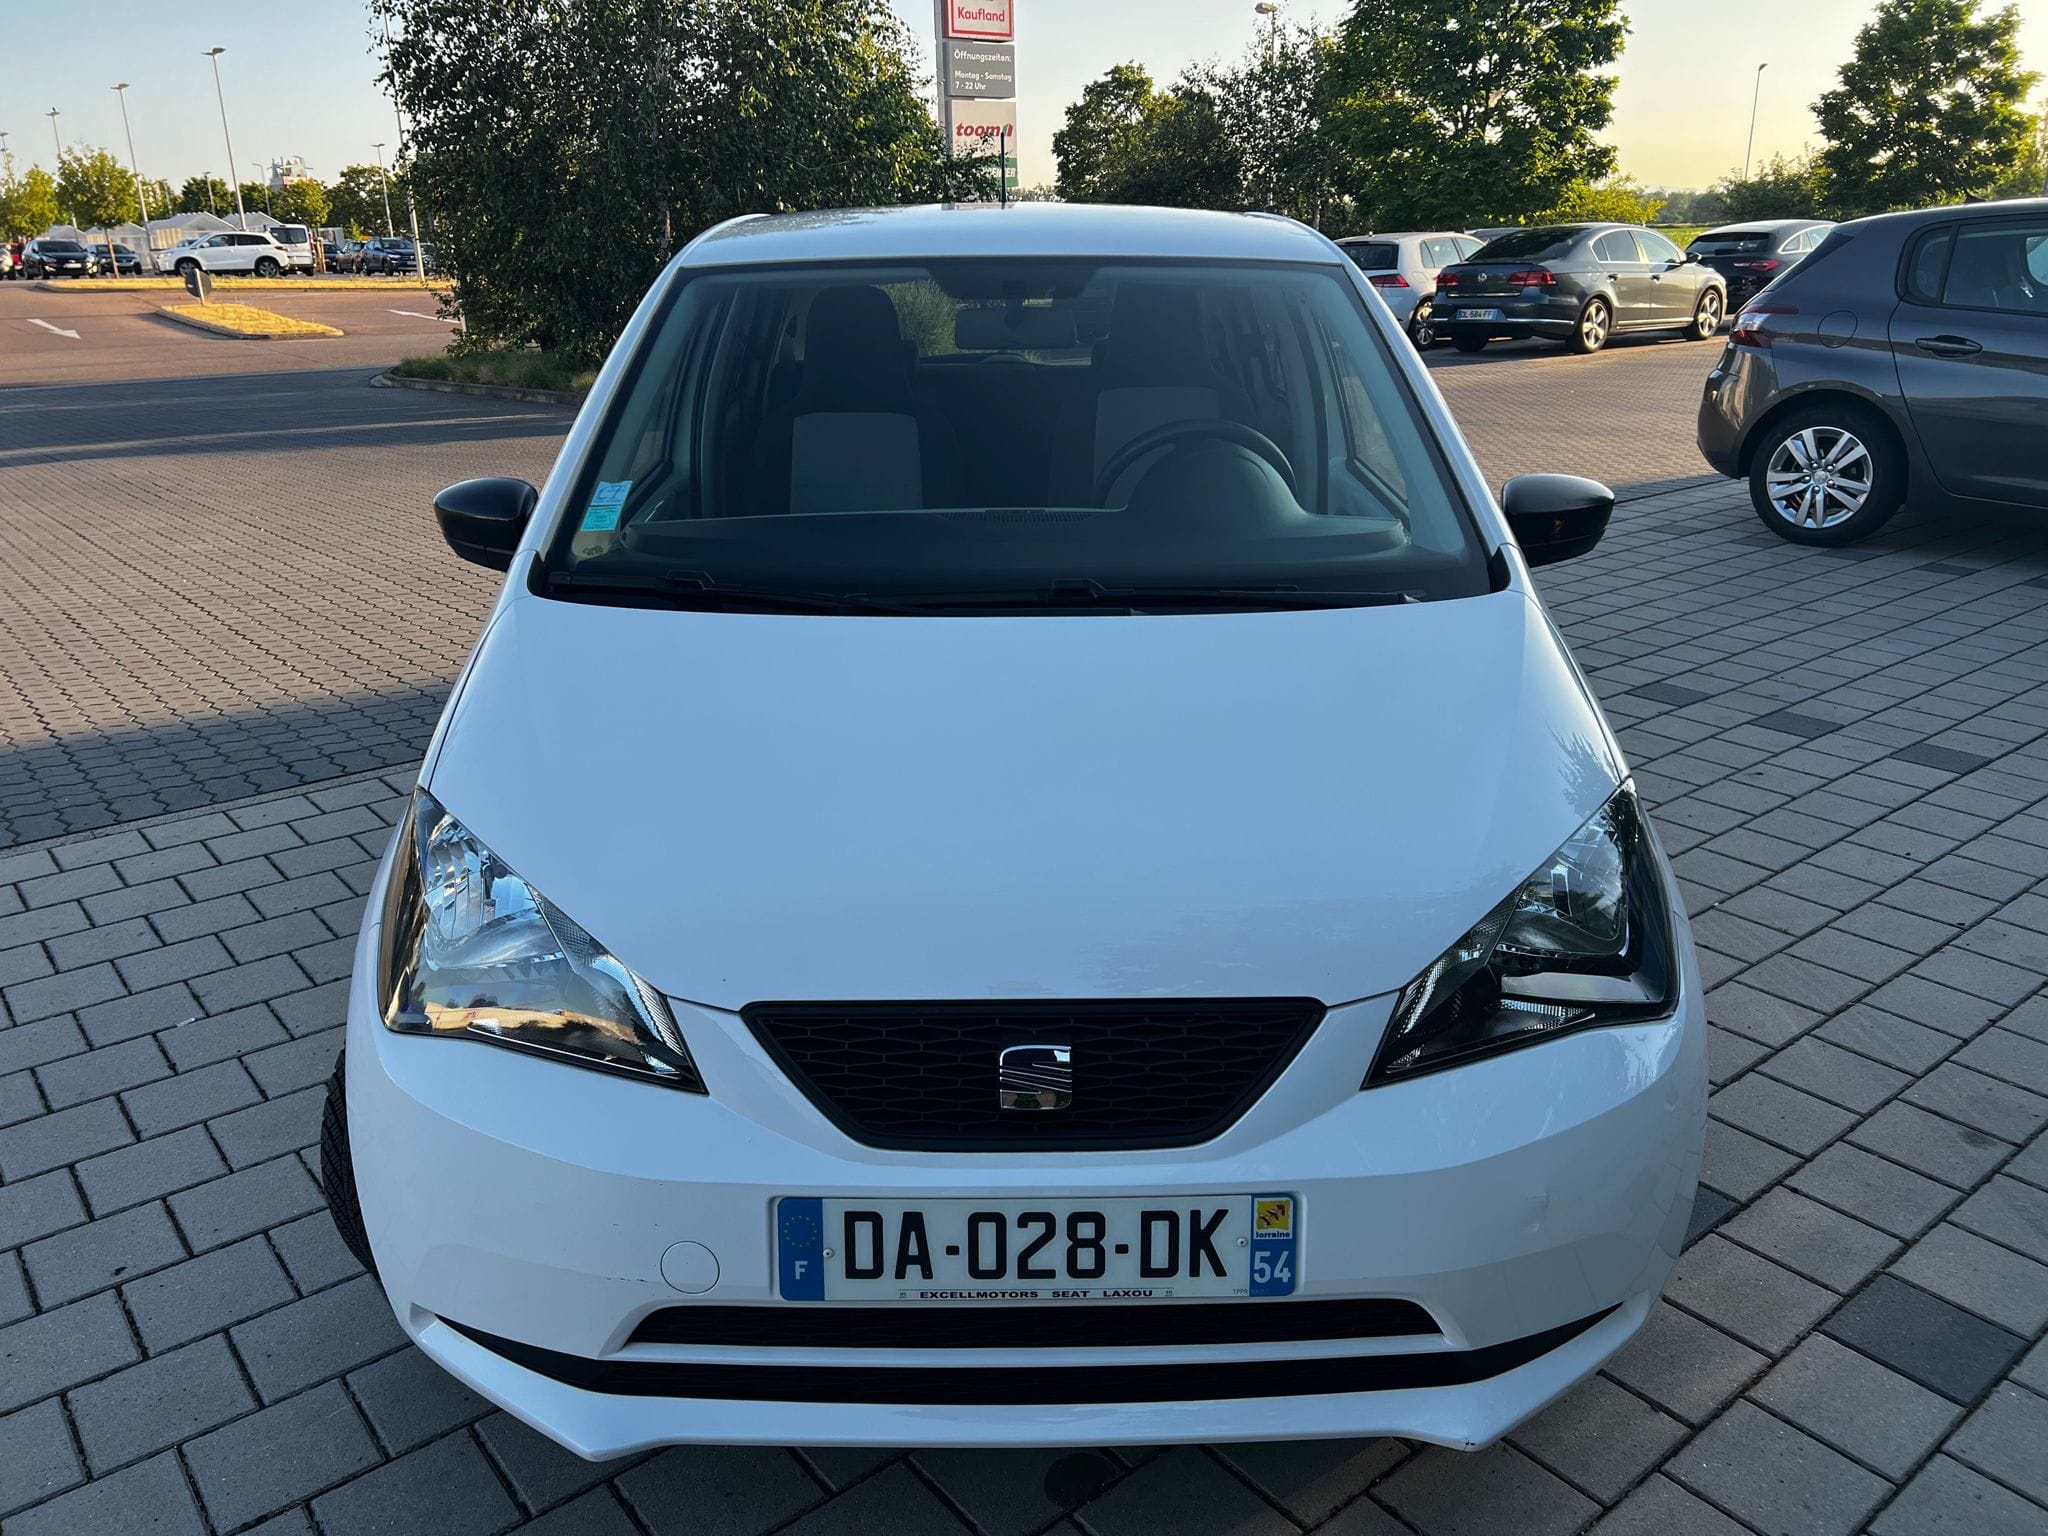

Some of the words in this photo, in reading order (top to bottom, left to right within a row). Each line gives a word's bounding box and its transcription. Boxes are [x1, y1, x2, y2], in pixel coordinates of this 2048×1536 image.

[957, 6, 1005, 22] Kaufland
[954, 48, 1012, 62] Öffnungszeiten:
[954, 70, 980, 80] Montag
[984, 72, 1012, 82] Samstag
[955, 81, 960, 89] 7
[974, 82, 986, 90] Uhr
[956, 122, 1000, 137] toom
[843, 1209, 1230, 1281] DA-028-DK
[794, 1260, 808, 1280] F
[1253, 1250, 1291, 1284] 54
[920, 1289, 1039, 1299] EXCELLMOTORS
[1051, 1289, 1090, 1298] SEAT
[1102, 1289, 1153, 1298] LAXOU
